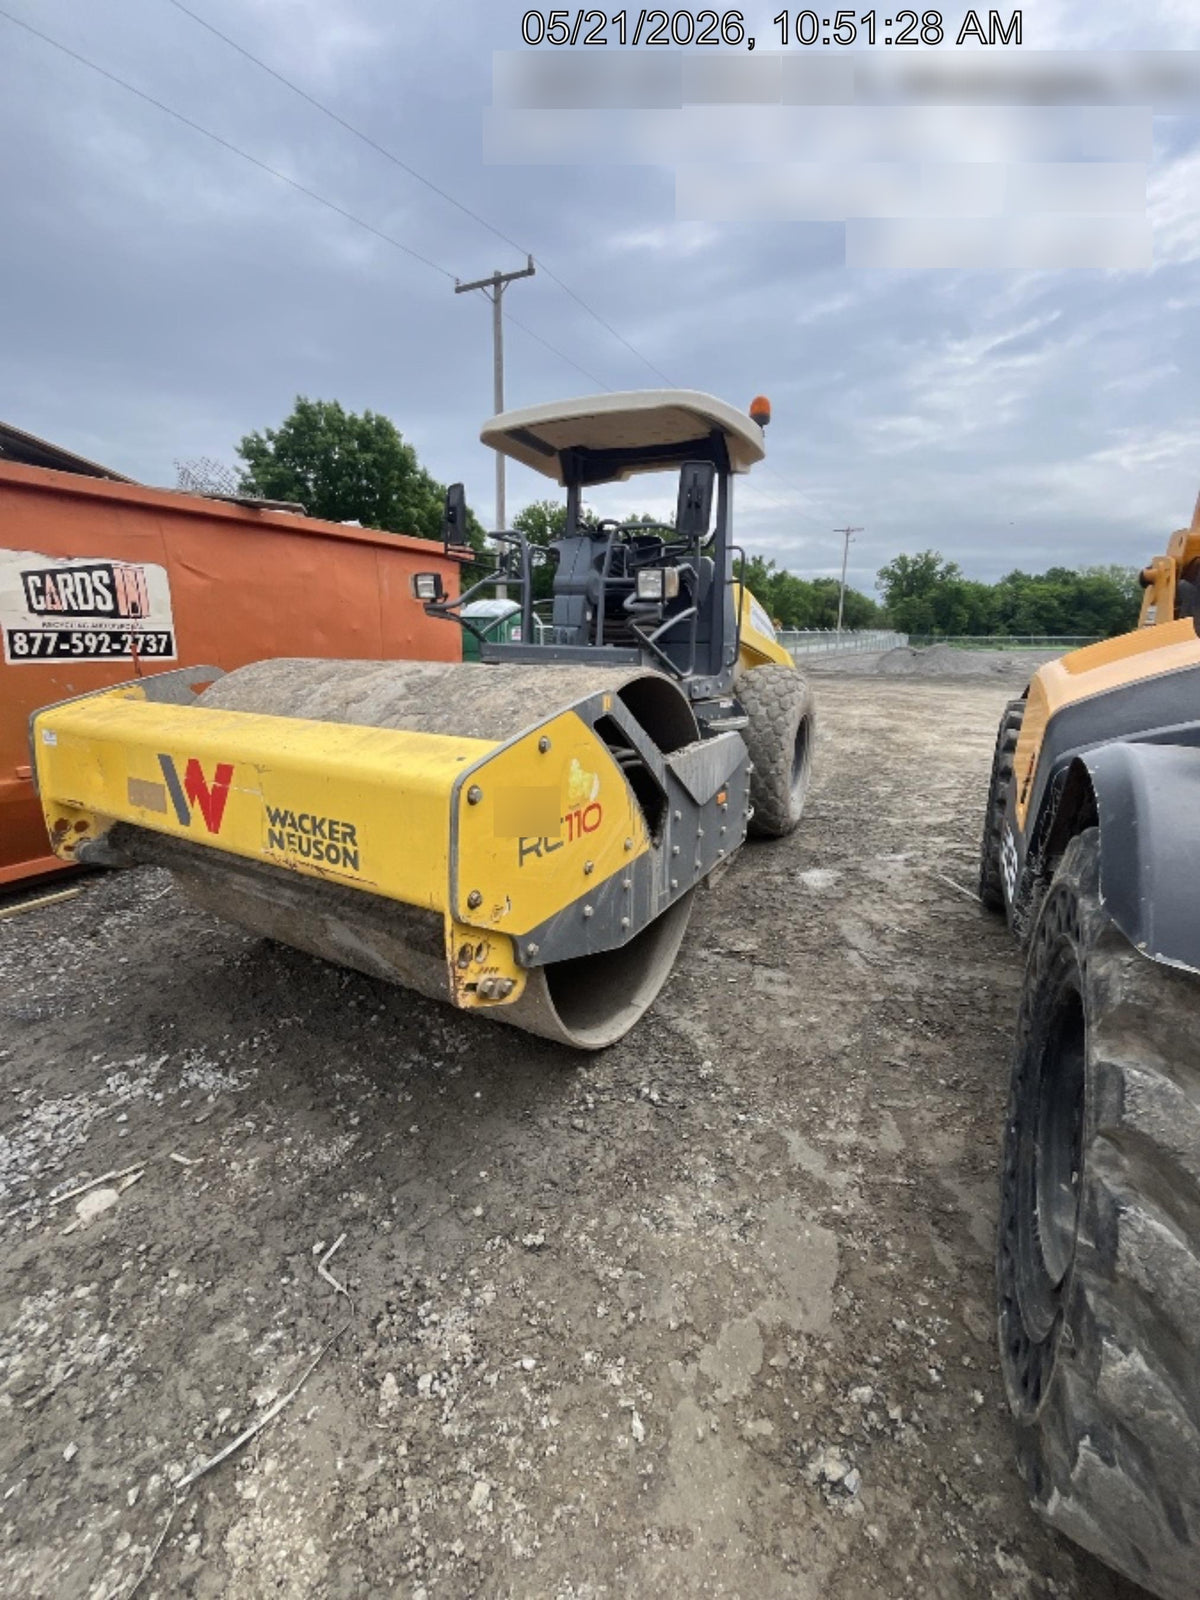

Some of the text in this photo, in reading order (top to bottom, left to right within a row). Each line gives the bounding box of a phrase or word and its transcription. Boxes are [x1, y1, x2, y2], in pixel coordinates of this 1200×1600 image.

[28, 570, 114, 611] CARDS
[13, 632, 168, 655] 877-592-2737
[266, 805, 358, 846] WACKER
[268, 828, 360, 871] NEUSON
